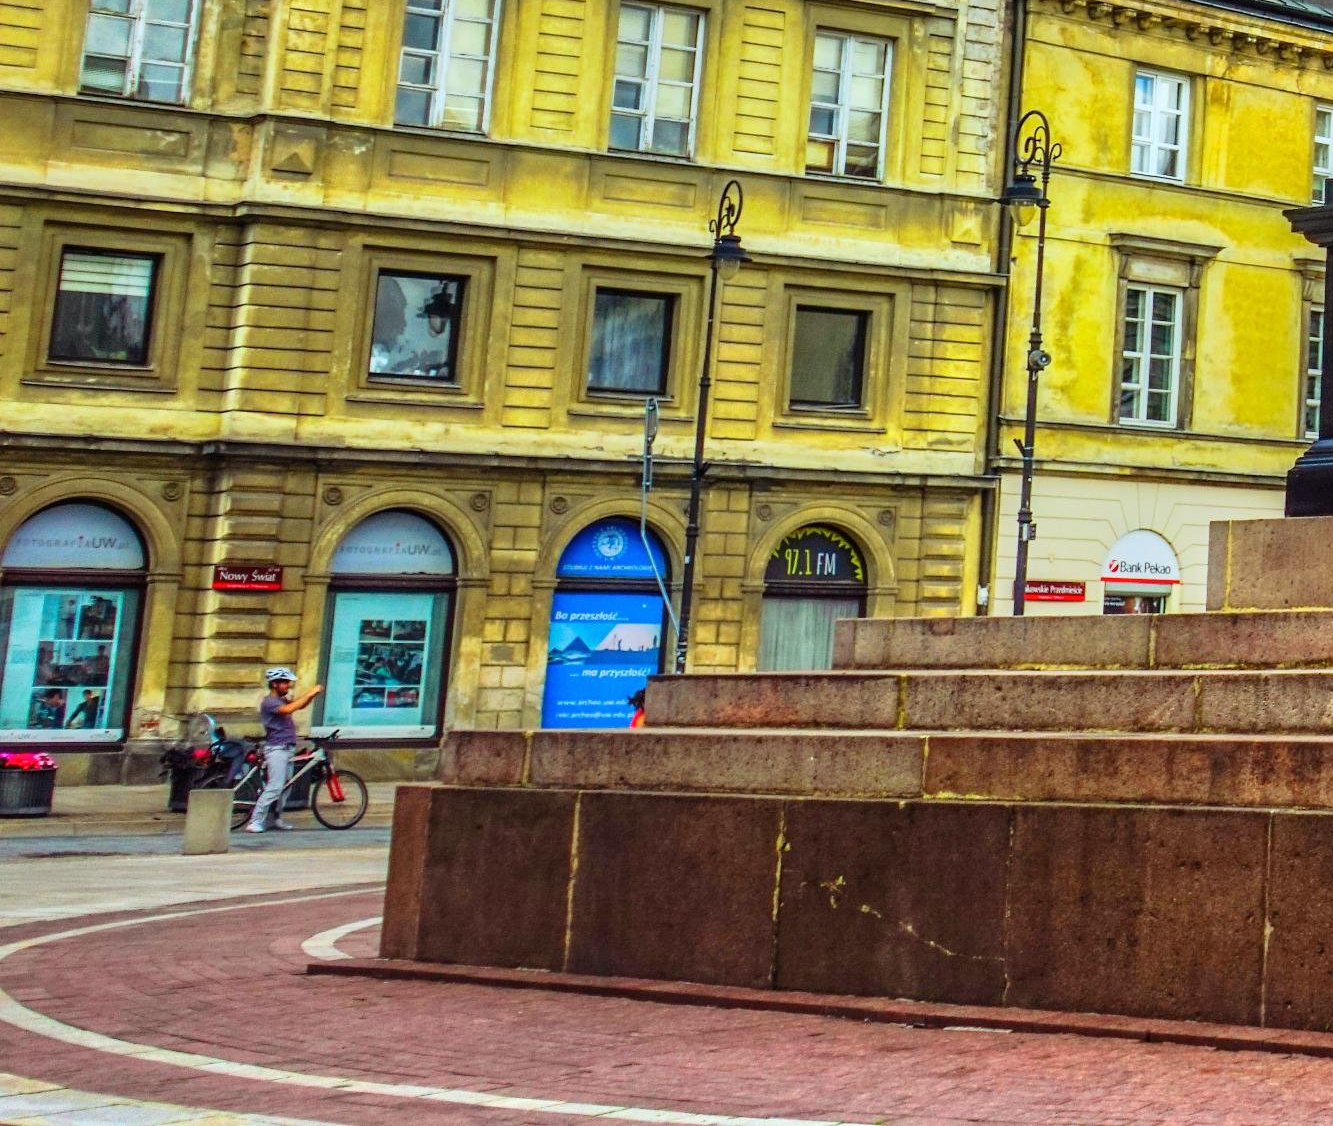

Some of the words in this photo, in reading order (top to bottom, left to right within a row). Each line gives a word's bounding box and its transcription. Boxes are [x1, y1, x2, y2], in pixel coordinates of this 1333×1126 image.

[785, 548, 812, 576] 97.1
[816, 552, 836, 576] FM
[1120, 561, 1142, 573] Bank
[1144, 562, 1171, 574] Pekao
[220, 571, 248, 583] Nowy
[252, 569, 276, 582] Świat
[555, 611, 568, 620] Bo
[582, 669, 598, 677] ma
